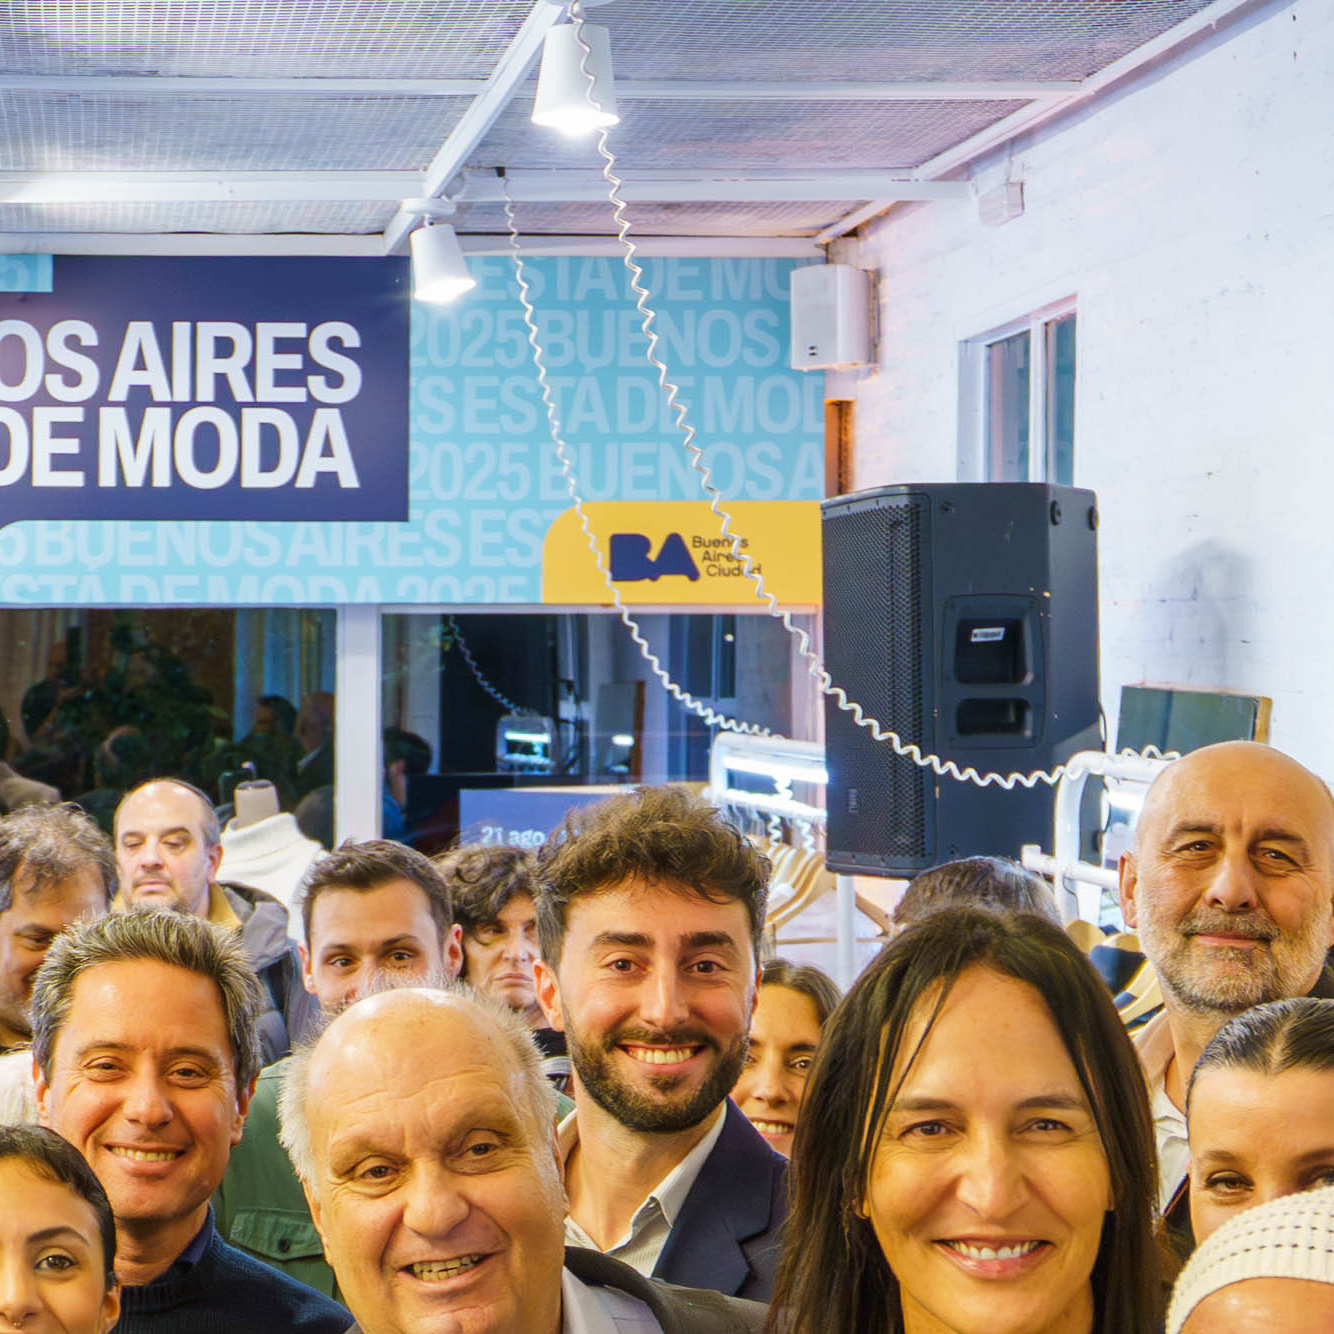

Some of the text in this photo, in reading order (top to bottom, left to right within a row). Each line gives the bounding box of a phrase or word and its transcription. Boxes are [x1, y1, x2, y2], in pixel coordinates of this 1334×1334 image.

[108, 321, 362, 403] AIRES
[537, 309, 780, 368] BUENOS
[98, 406, 360, 488] MODA
[539, 442, 784, 501] BUENOS
[37, 522, 285, 567] BUENOS
[287, 509, 463, 567] AIRES
[609, 532, 700, 581] BA
[706, 563, 762, 577] Ciudd
